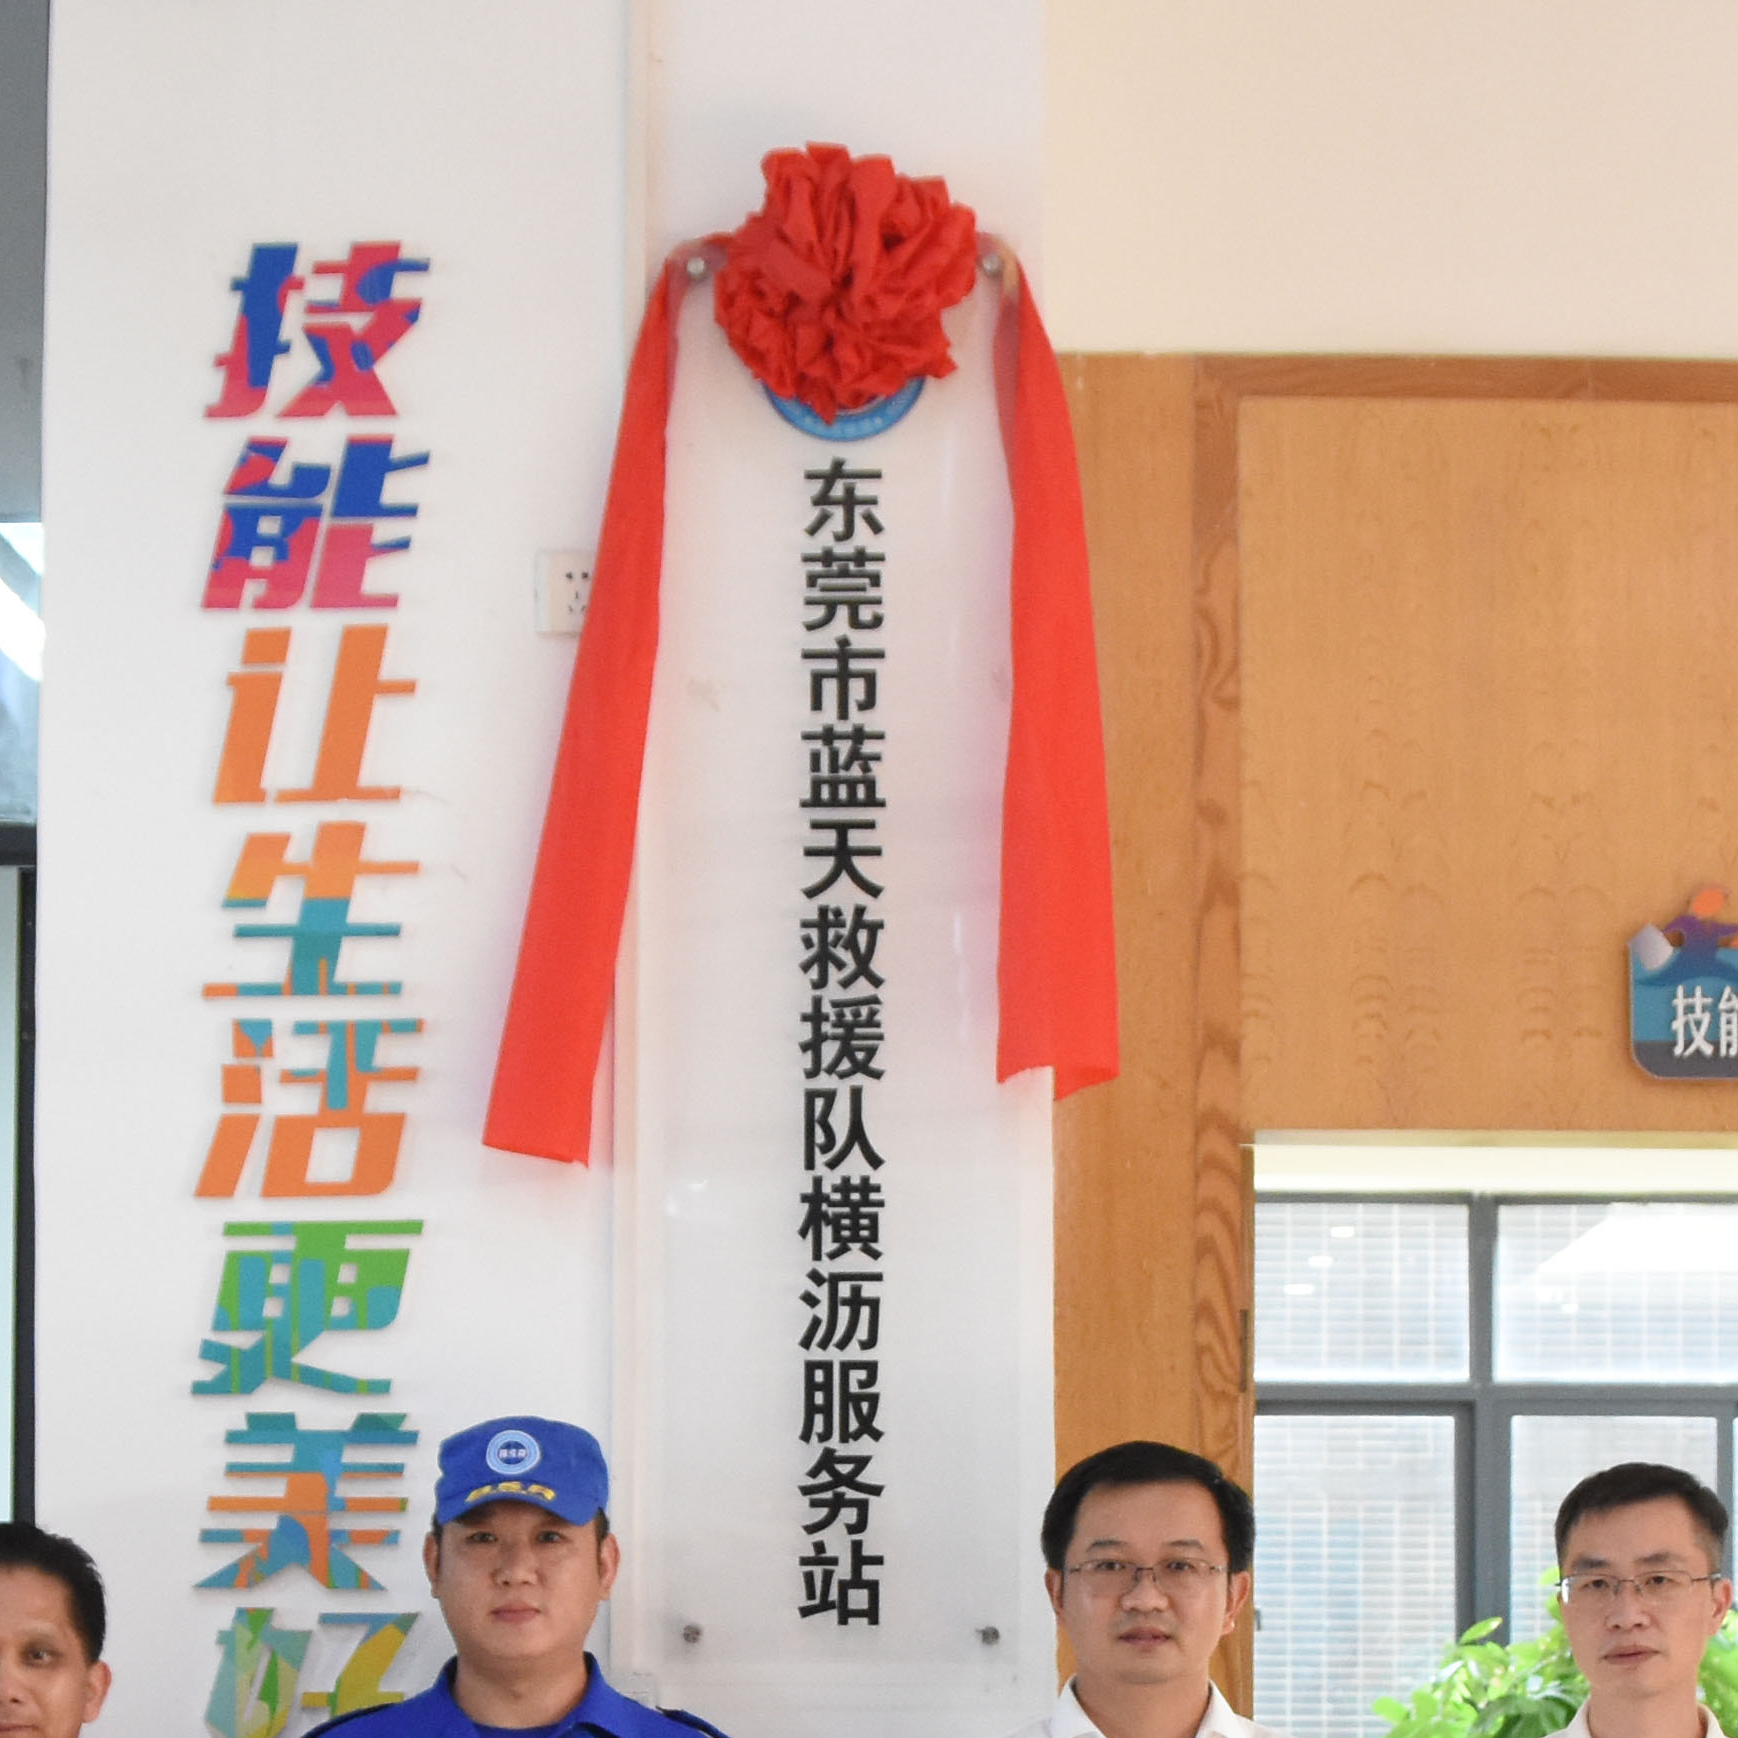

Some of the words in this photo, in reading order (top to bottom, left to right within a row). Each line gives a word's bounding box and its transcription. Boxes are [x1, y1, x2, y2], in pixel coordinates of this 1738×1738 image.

[797, 457, 887, 1627] 东莞市蓝天救援队横沥服务站
